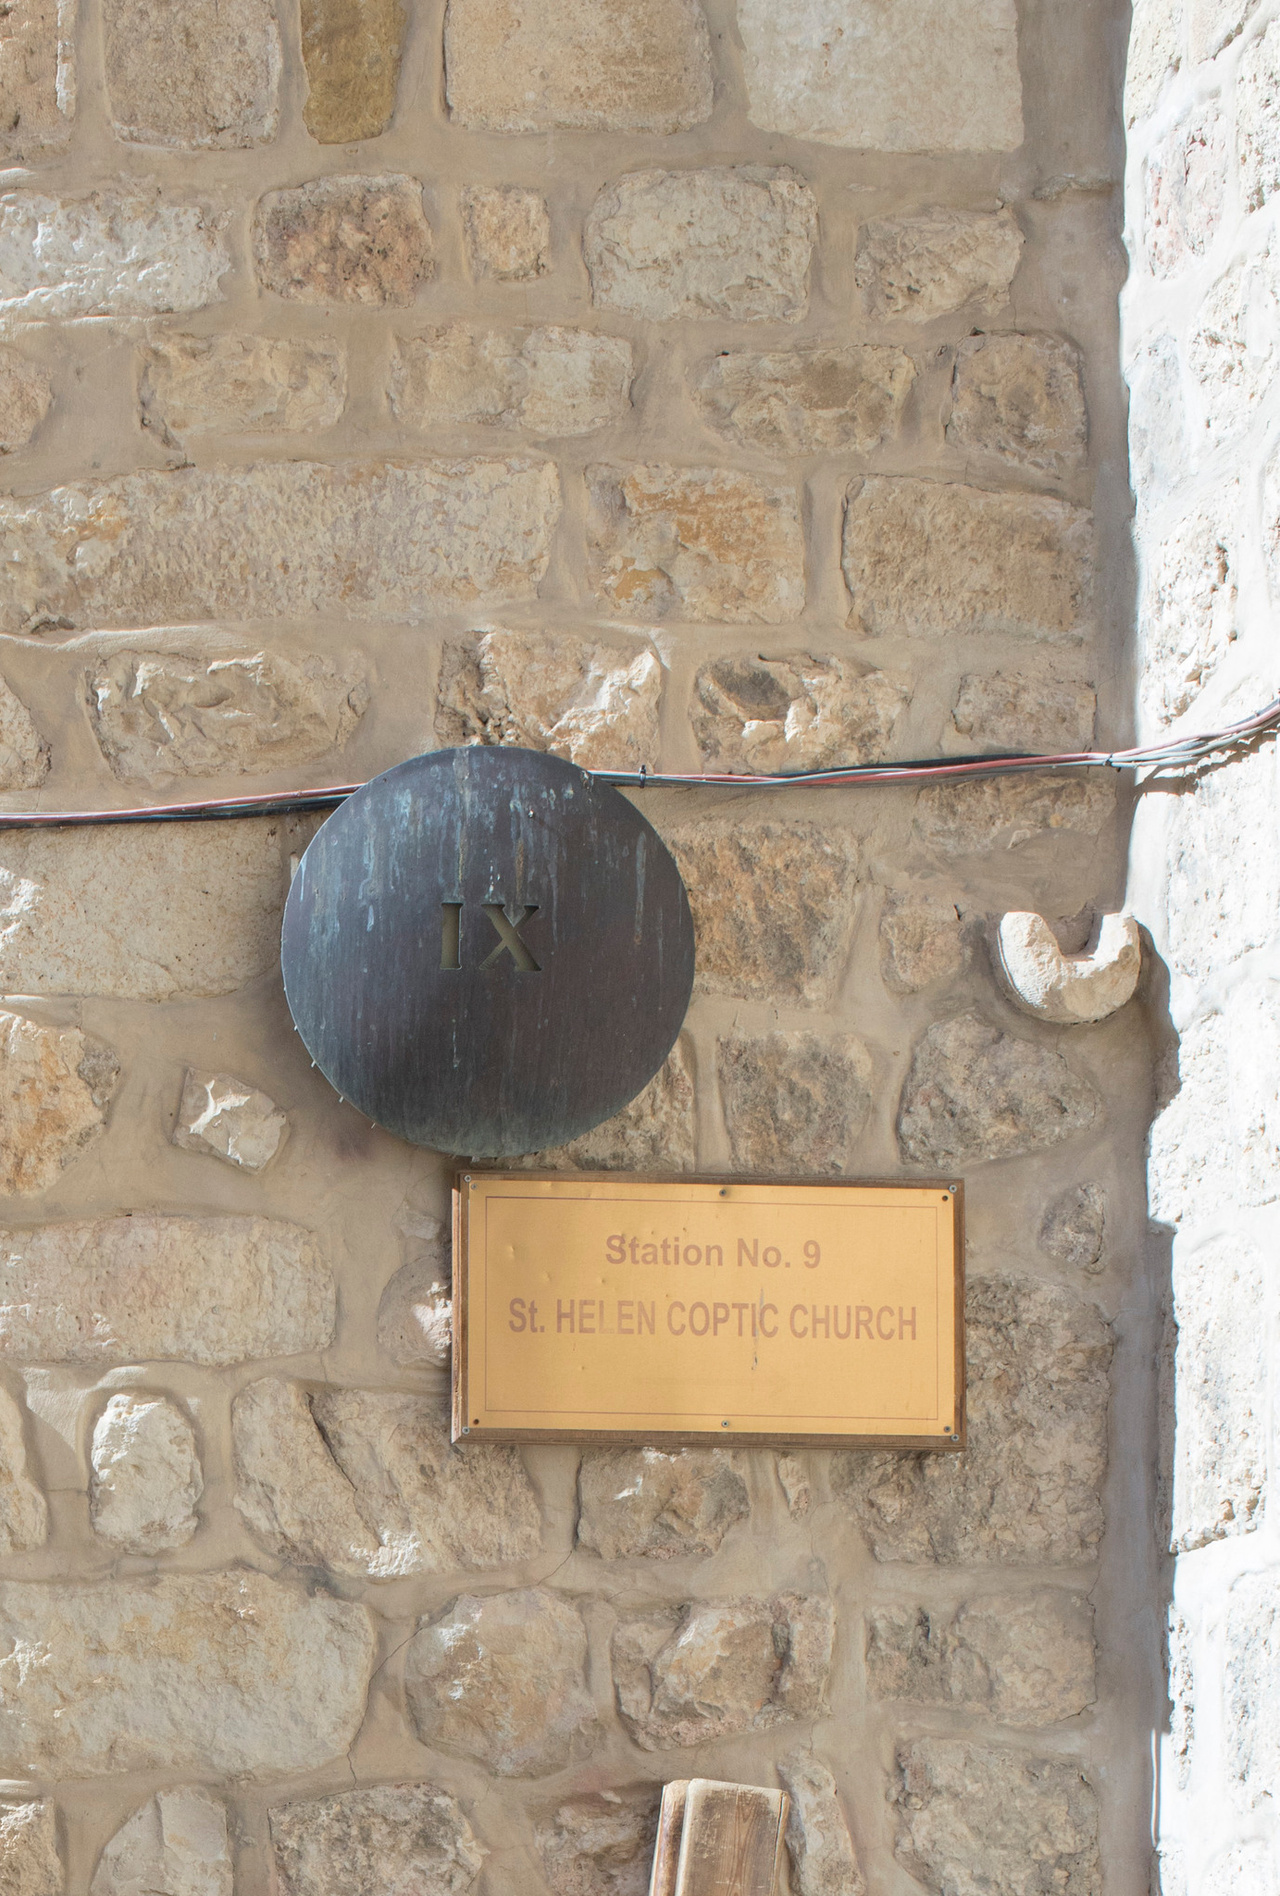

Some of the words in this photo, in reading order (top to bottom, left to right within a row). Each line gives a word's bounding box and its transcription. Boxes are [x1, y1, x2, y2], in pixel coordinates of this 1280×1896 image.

[440, 902, 542, 972] IX
[605, 1234, 723, 1266] Station
[737, 1238, 791, 1268] No.
[803, 1240, 821, 1269] 9
[508, 1297, 545, 1334] St.
[557, 1299, 656, 1335] HELEN
[667, 1301, 779, 1338] COPTIC
[790, 1304, 918, 1341] CHURCH
